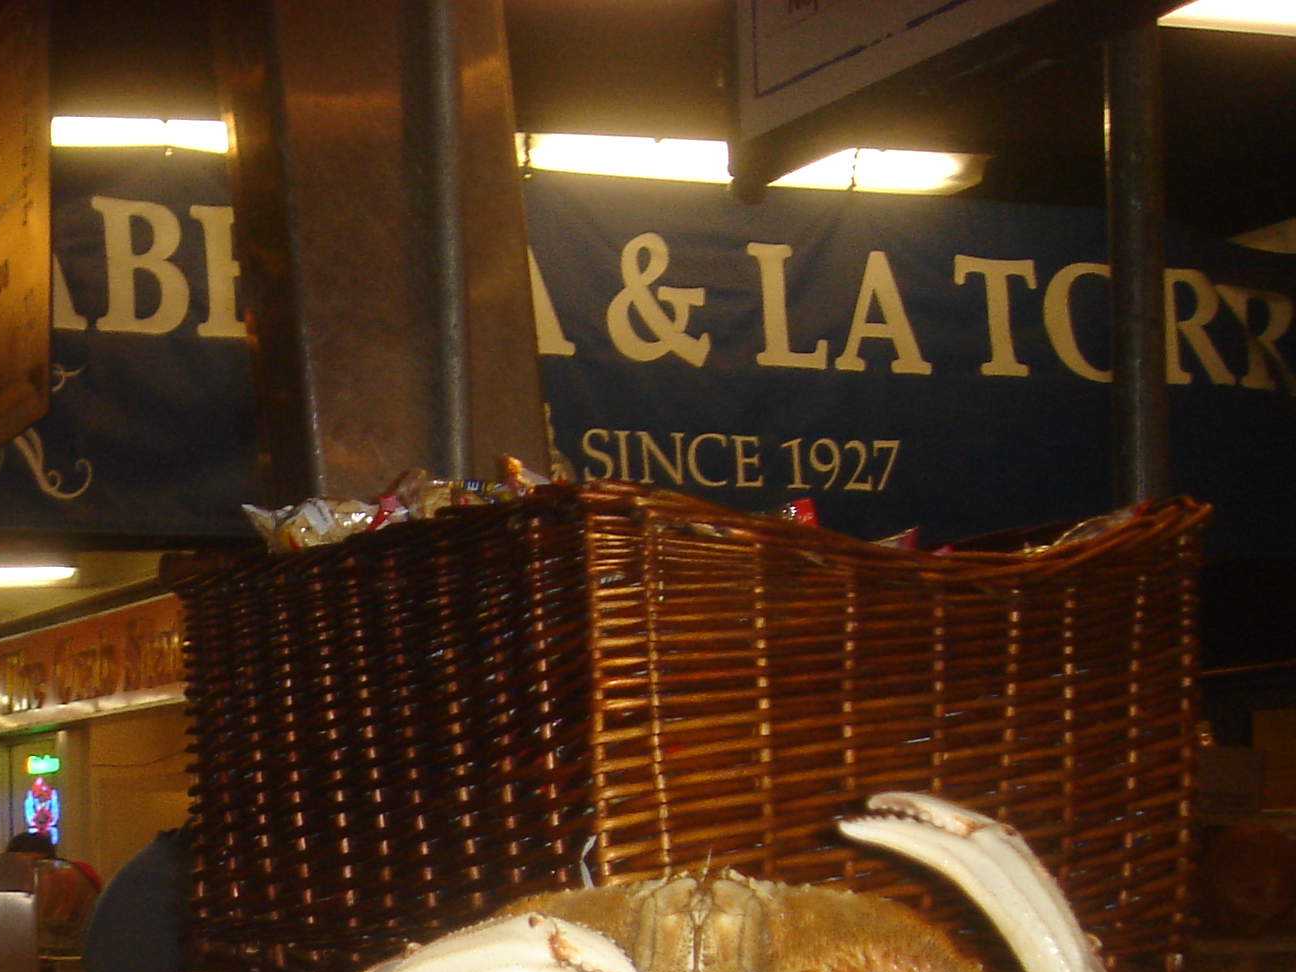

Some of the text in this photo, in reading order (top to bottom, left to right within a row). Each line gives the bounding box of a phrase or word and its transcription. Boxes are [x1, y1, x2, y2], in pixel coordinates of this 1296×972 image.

[607, 232, 711, 368] &
[746, 242, 932, 375] LA
[580, 427, 901, 491] SINCE 1927
